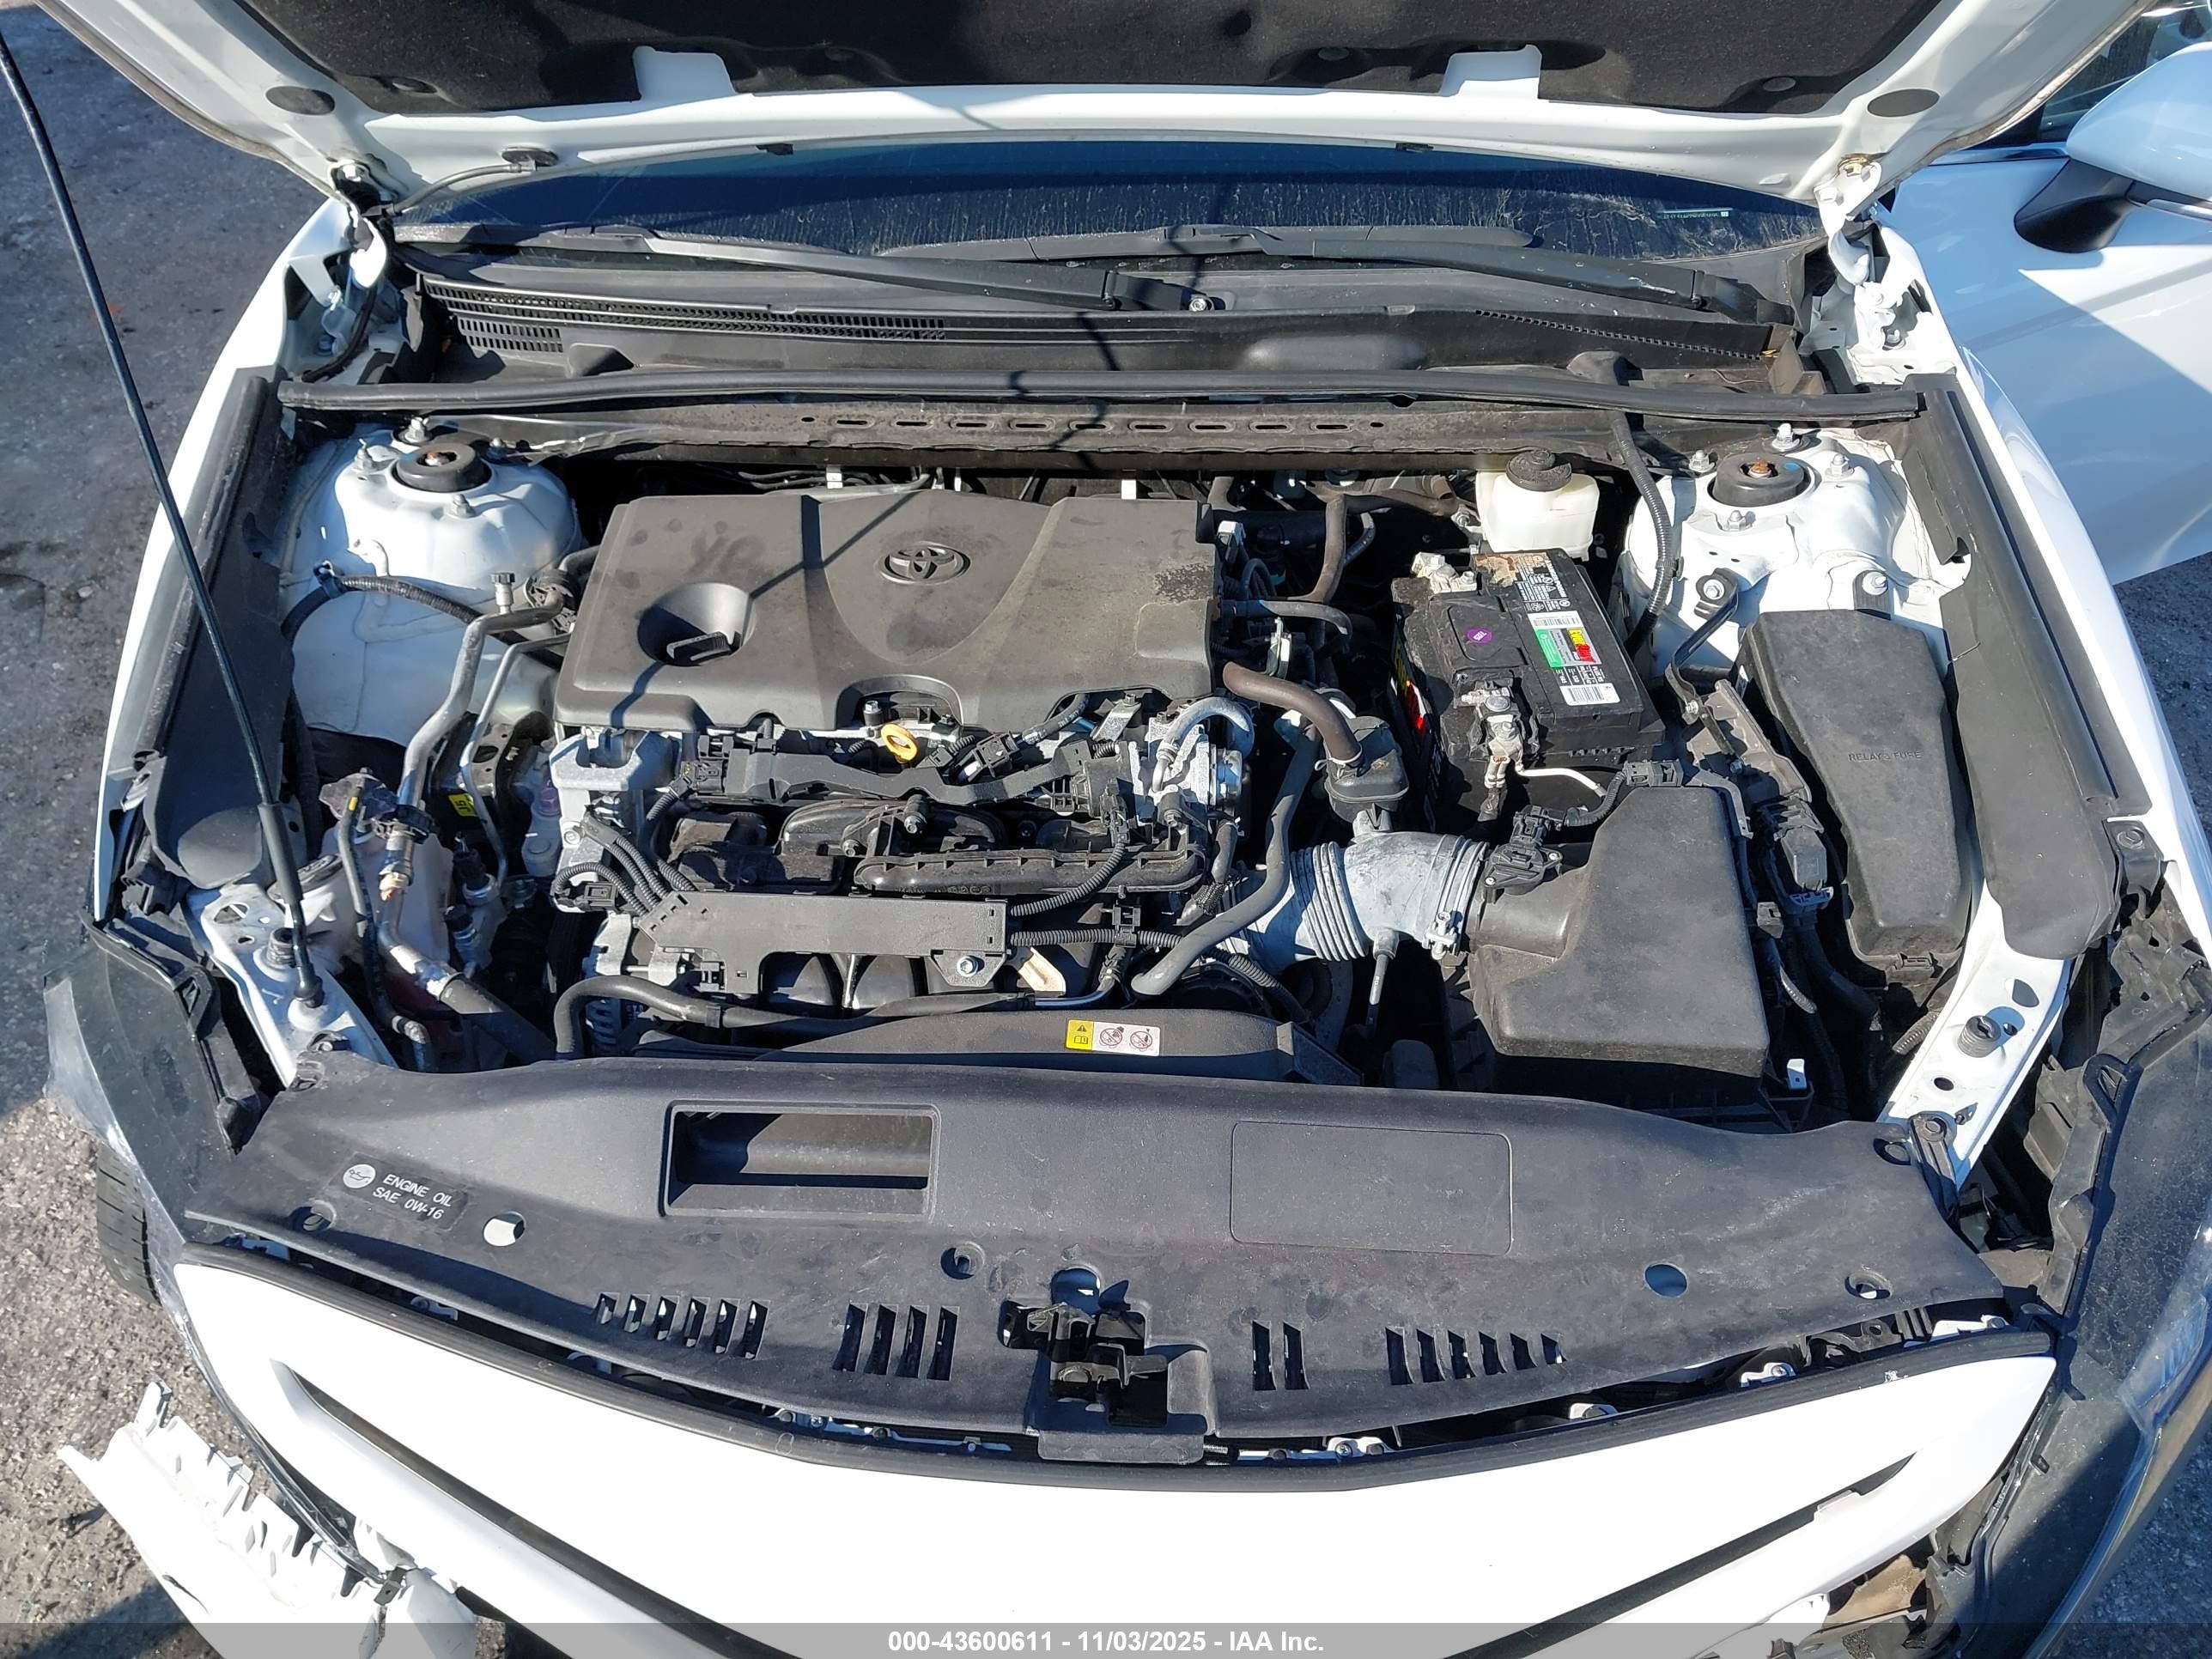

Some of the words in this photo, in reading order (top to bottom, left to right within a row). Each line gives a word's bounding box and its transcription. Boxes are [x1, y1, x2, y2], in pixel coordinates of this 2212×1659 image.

[1848, 752, 1882, 763] RELAY
[1893, 750, 1923, 760] FUSE
[373, 1187, 401, 1203] SAE
[404, 1199, 445, 1219] 0W-16
[383, 1174, 429, 1197] ENGINE
[433, 1193, 453, 1206] OIL
